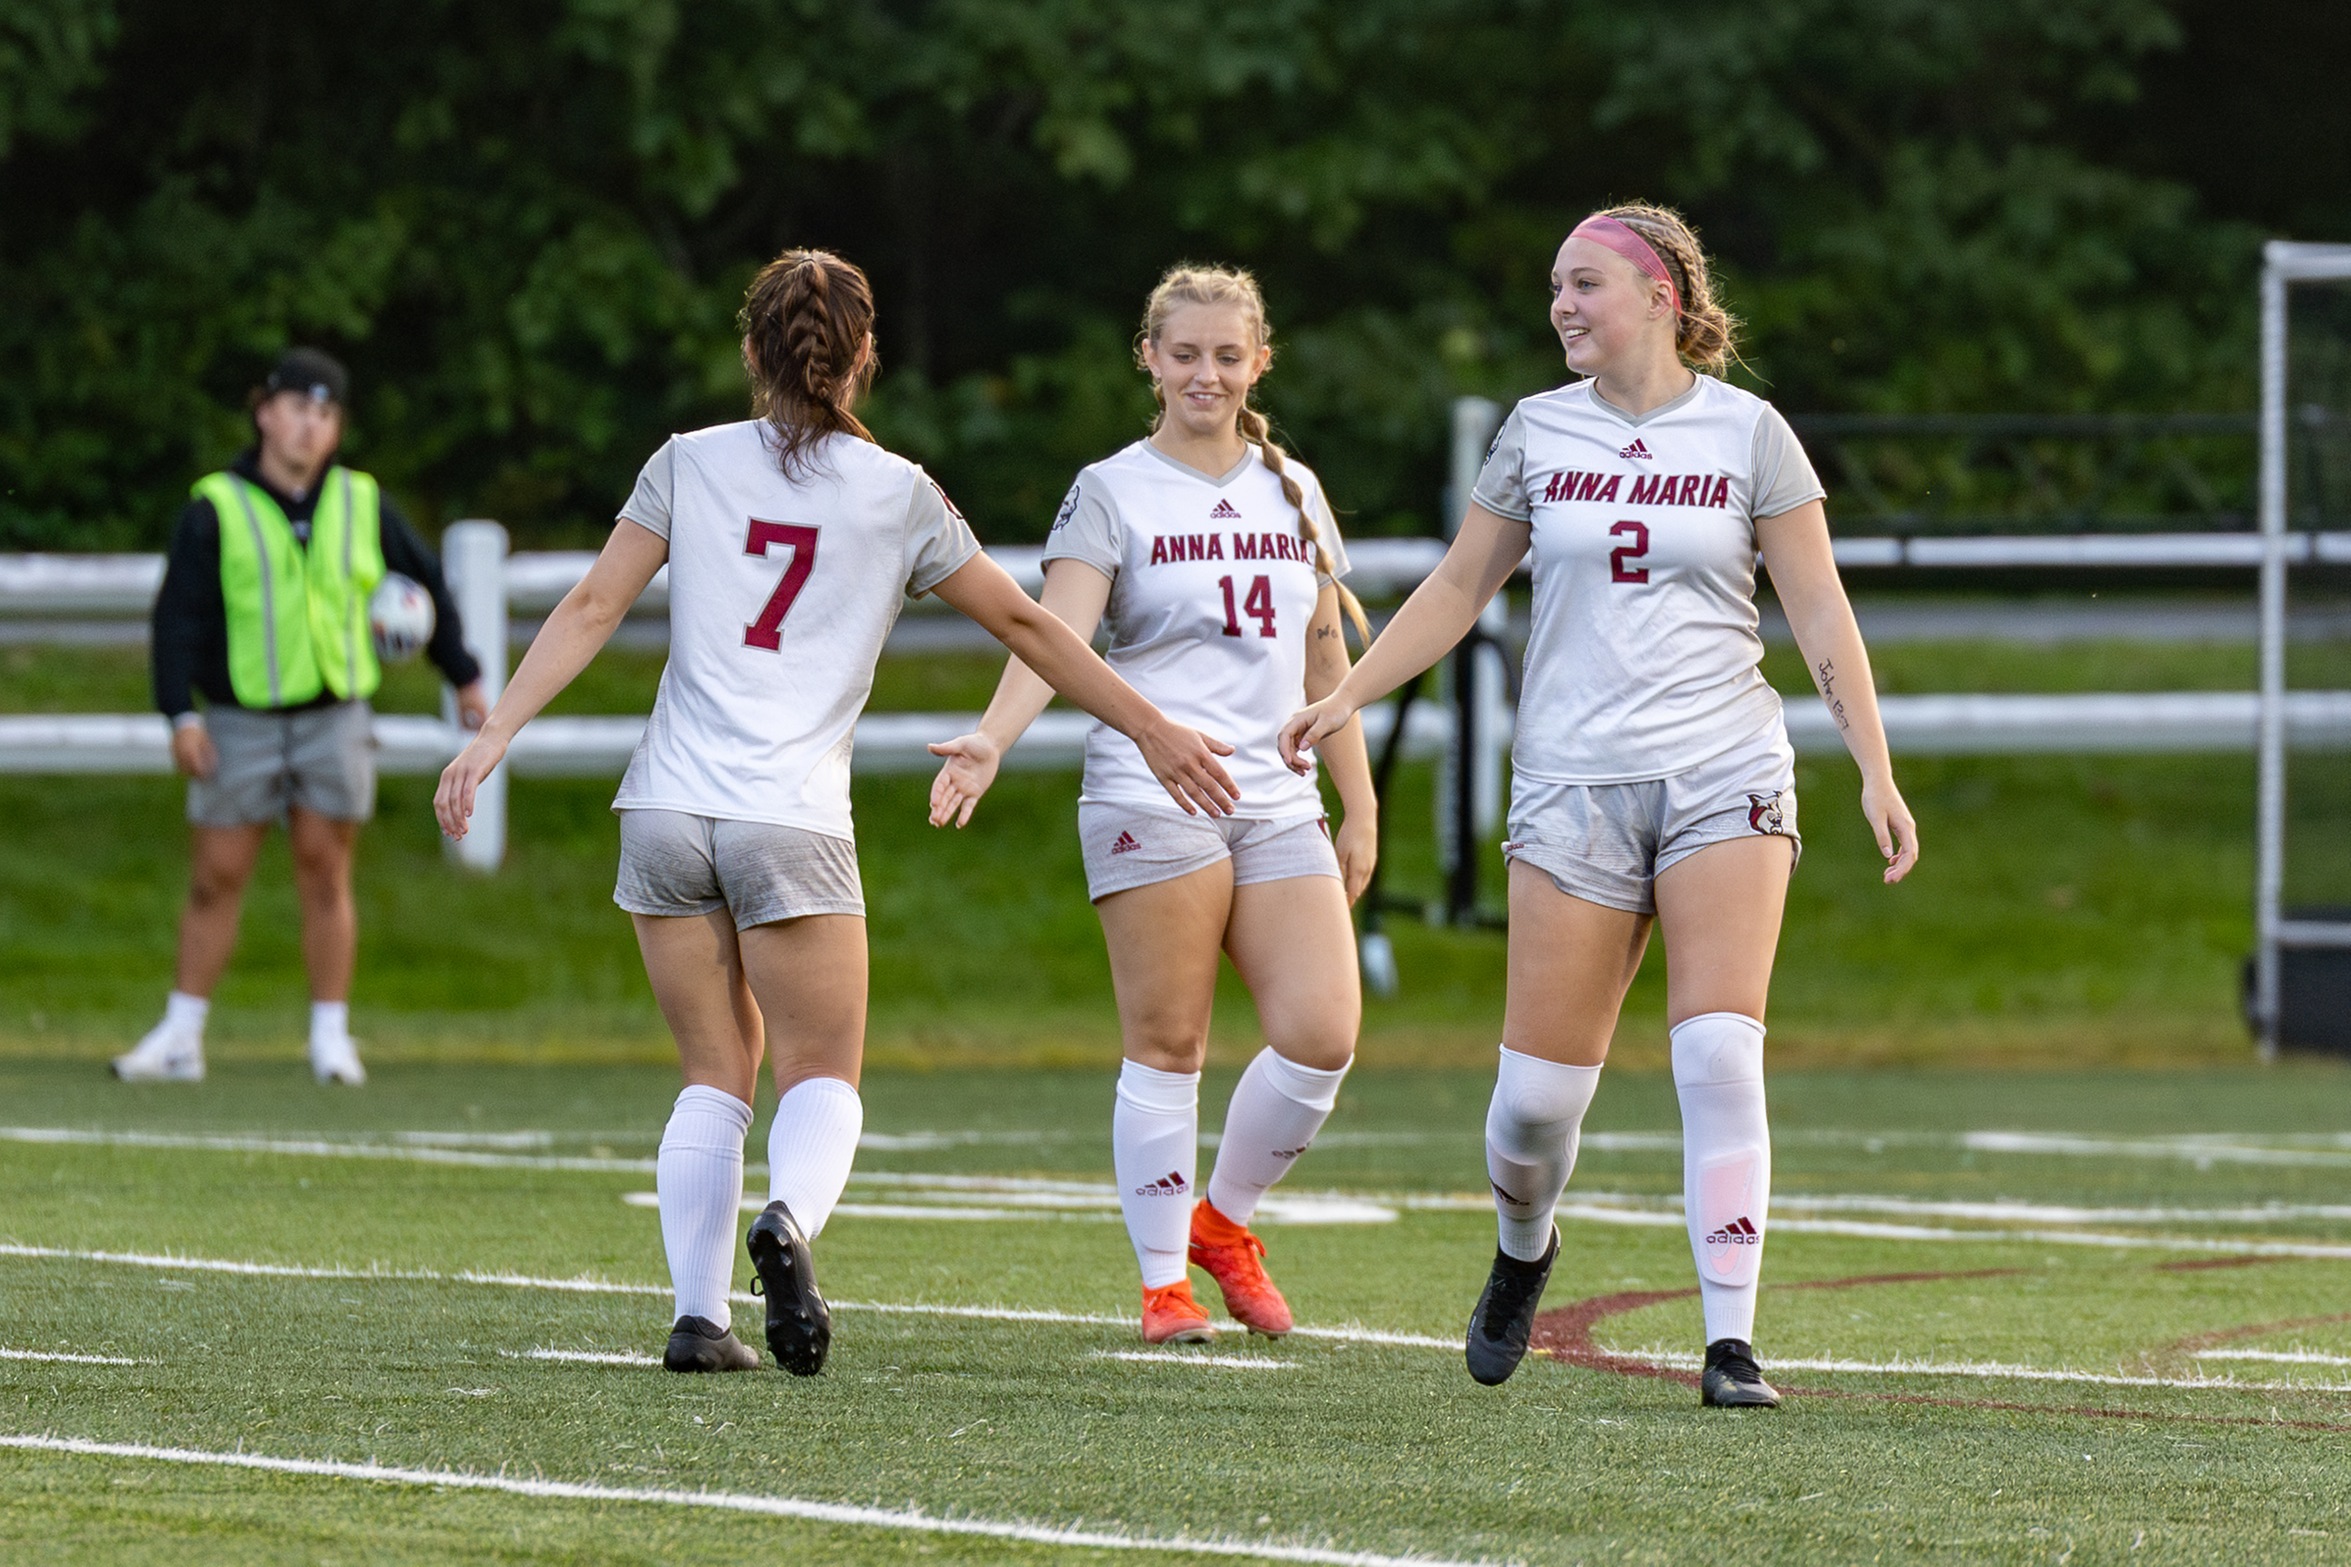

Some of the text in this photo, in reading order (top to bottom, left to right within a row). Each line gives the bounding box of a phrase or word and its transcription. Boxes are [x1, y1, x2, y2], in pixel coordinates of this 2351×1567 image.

[1619, 450, 1653, 460] adidas
[1544, 470, 1731, 509] ANNA MARIA
[1210, 510, 1242, 519] adidas
[1150, 532, 1225, 566] ANNA
[1608, 520, 1650, 584] 2
[742, 515, 821, 654] 7
[1218, 574, 1277, 639] 14
[1818, 658, 1835, 701] John
[1111, 843, 1142, 855] adidas
[1135, 1183, 1189, 1197] adidas
[1705, 1233, 1761, 1245] adidas
